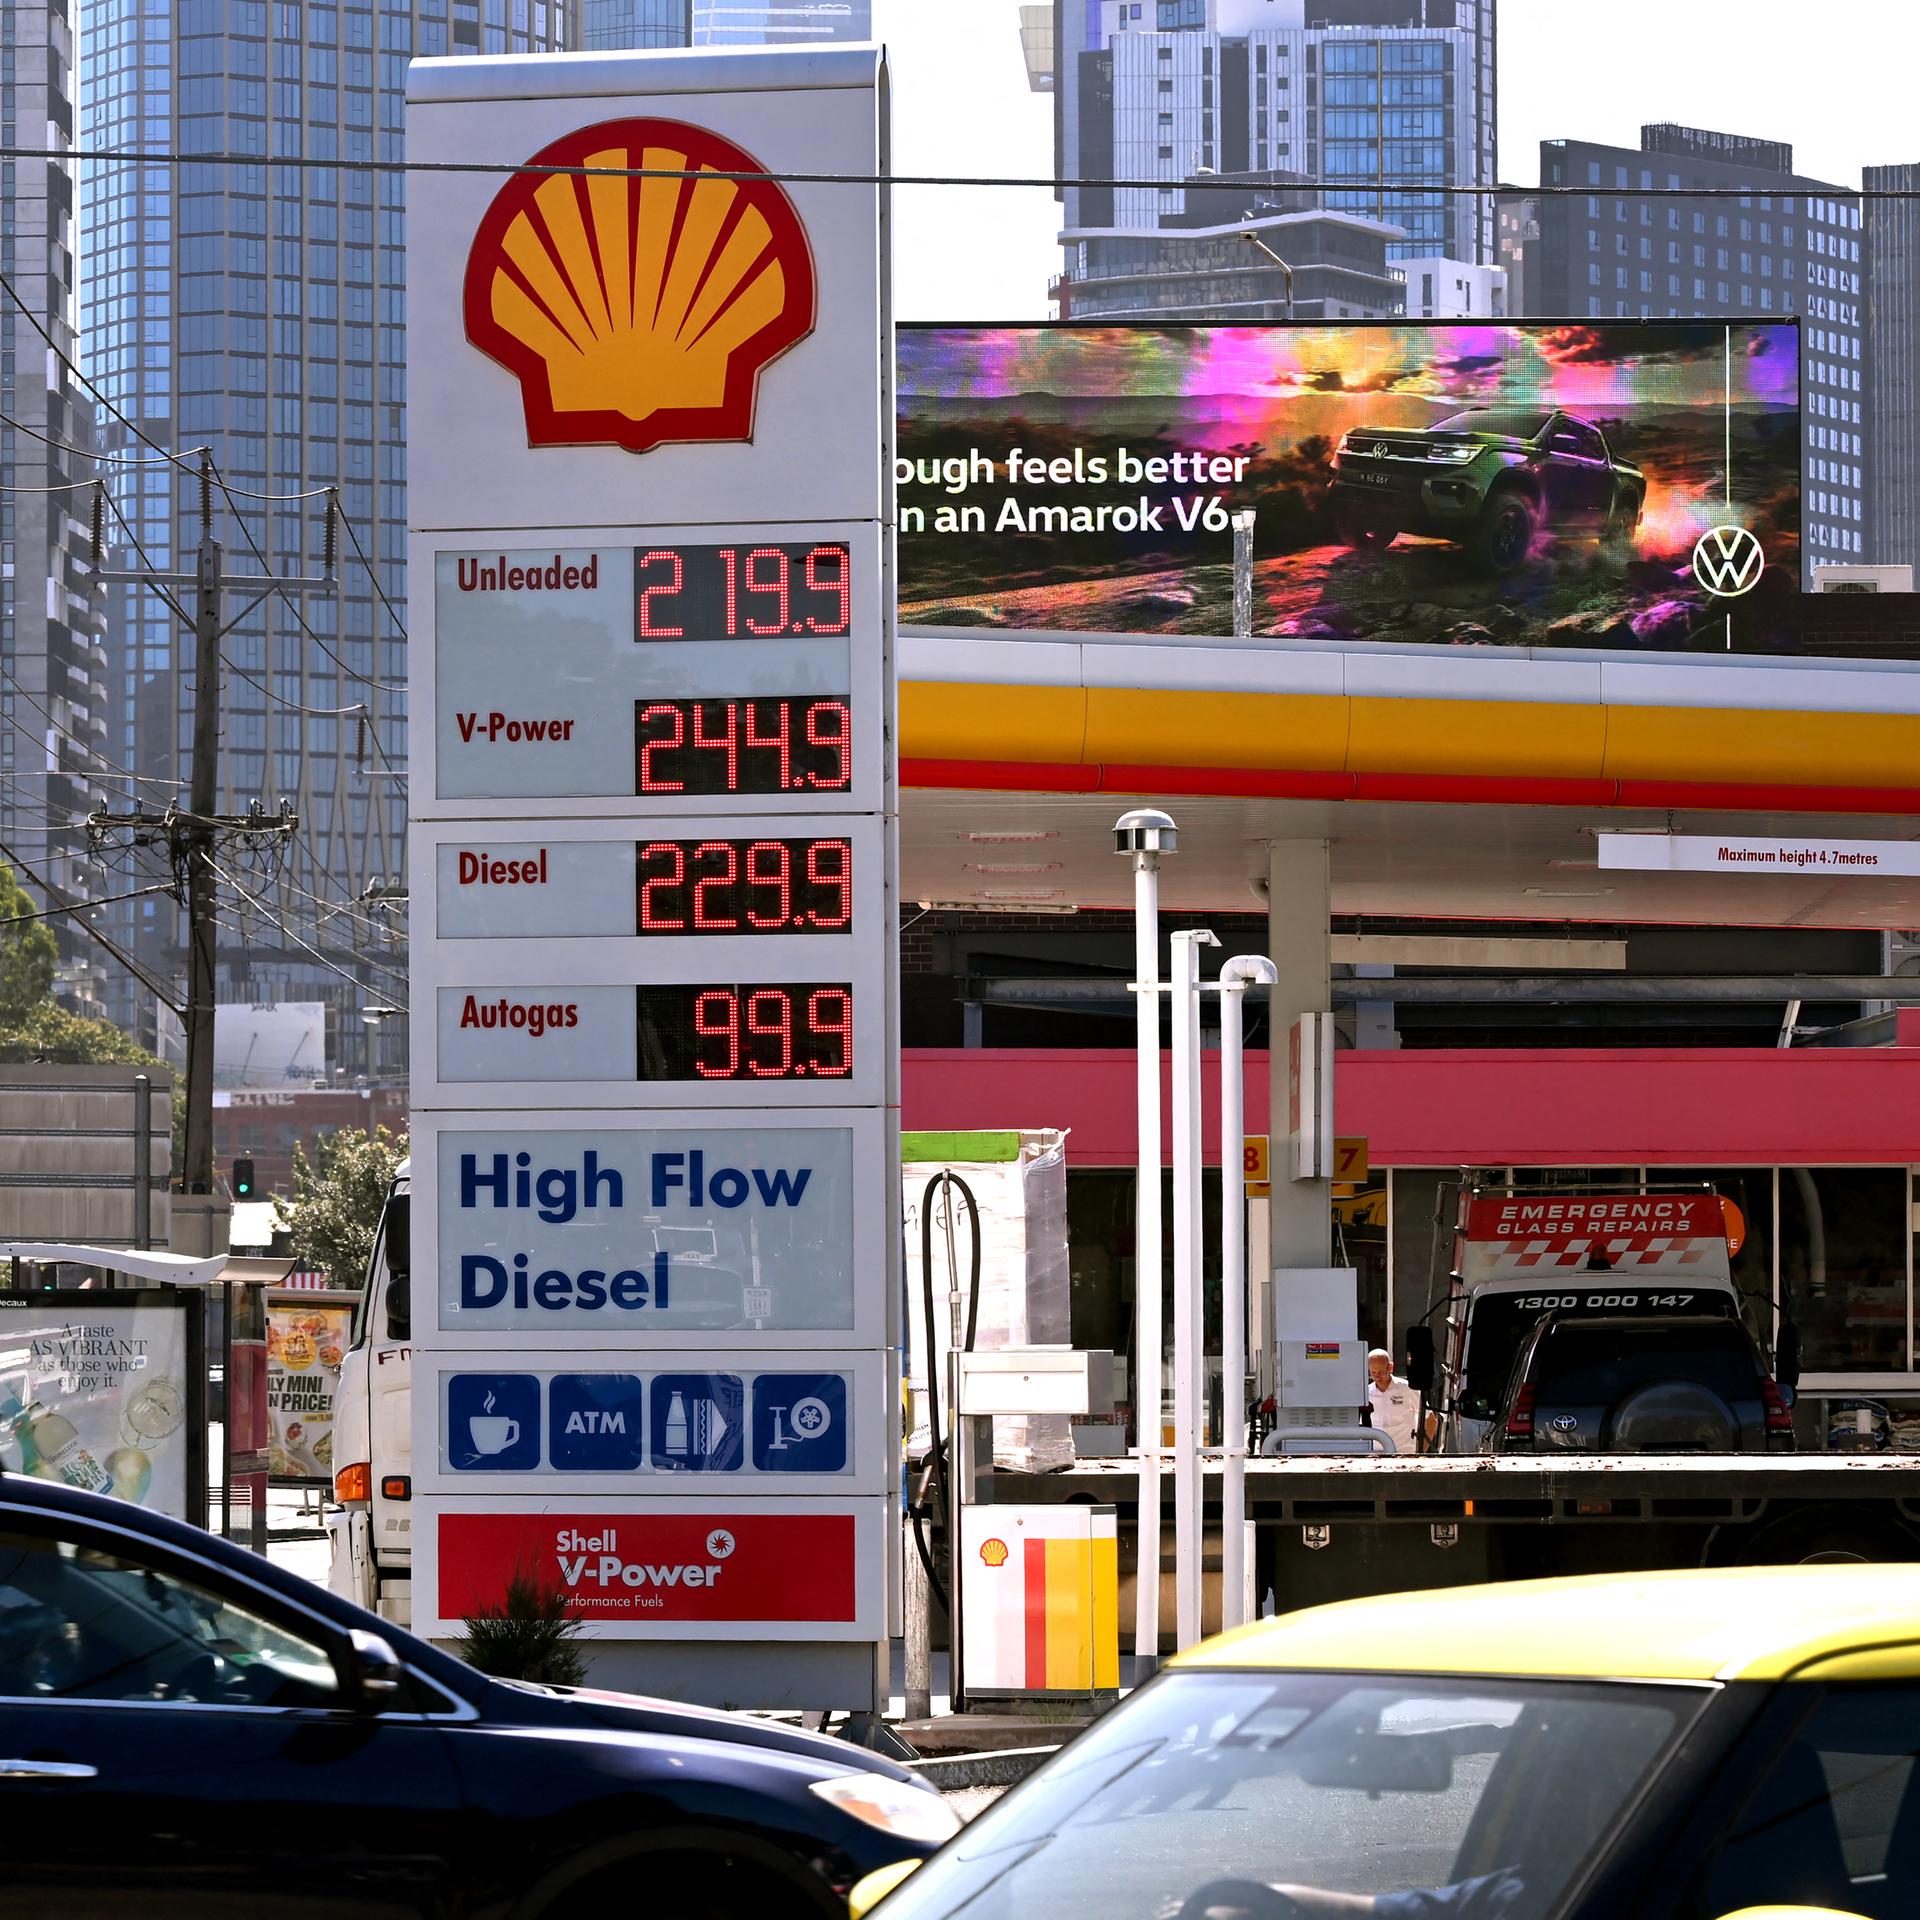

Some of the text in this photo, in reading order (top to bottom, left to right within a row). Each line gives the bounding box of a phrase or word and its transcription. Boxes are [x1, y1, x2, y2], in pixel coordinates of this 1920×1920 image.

[1006, 448, 1107, 484] feels
[1119, 448, 1251, 483] better
[935, 504, 986, 533] an
[995, 497, 1164, 533] Amarok
[457, 547, 849, 637] Unleaded 219.9
[456, 702, 850, 791] V-Power 244.9
[1718, 847, 1878, 866] Maximum height 4.7metres
[459, 841, 850, 929] Diesel 229.9
[460, 989, 852, 1077] Autogas 99.9
[1244, 1146, 1259, 1172] 8
[1340, 1148, 1359, 1172] 7
[460, 1149, 812, 1224] High Flow
[1501, 1202, 1696, 1220] EMERGENCY
[1496, 1220, 1691, 1234] GLASS REPAIRS
[460, 1251, 669, 1310] Diesel
[0, 1299, 27, 1307] ecaux
[1514, 1295, 1695, 1309] 1300 000 147
[61, 1323, 115, 1338] A taste
[30, 1340, 148, 1356] AS VIBRANT
[38, 1356, 138, 1372] as those who
[58, 1373, 118, 1392] enjoy it.
[287, 1376, 323, 1393] MINI
[281, 1393, 333, 1411] PRICE!
[565, 1411, 626, 1434] ATM
[556, 1529, 616, 1552] Shell
[556, 1556, 722, 1587] V-Power
[556, 1593, 664, 1608] Performance Fuels
